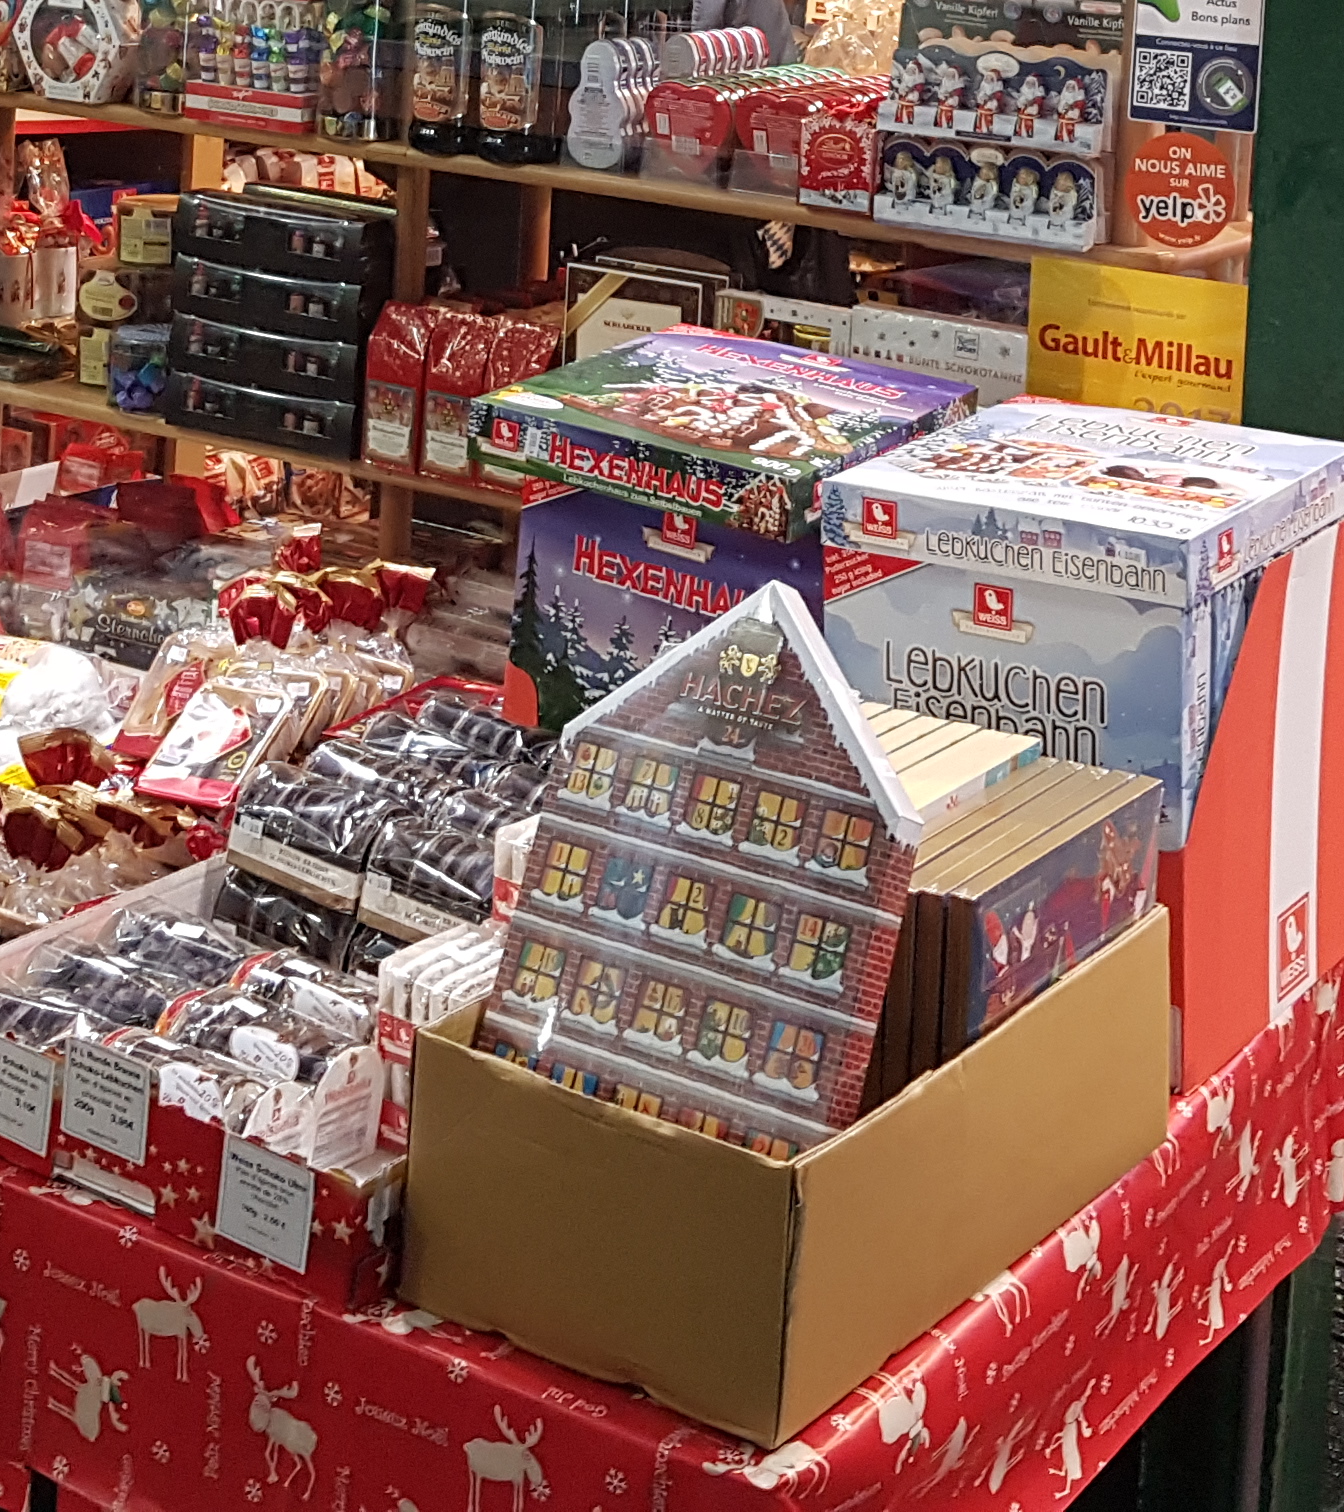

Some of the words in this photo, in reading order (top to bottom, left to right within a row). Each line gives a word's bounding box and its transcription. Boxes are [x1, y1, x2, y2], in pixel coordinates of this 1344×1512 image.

[934, 0, 965, 15] Vanille
[967, 4, 999, 19] Kipferl
[1067, 14, 1101, 29] Vanille
[1102, 17, 1124, 32] Kipf
[1191, 11, 1218, 24] Bons
[1220, 13, 1251, 27] plans
[1168, 145, 1193, 160] ON
[1134, 156, 1182, 175] NOUS
[1184, 161, 1227, 179] AIME
[1169, 177, 1190, 188] SUR
[1138, 194, 1195, 228] yelp
[1039, 322, 1233, 380] Gault&Millau
[693, 343, 907, 401] HEXENHAUS
[908, 354, 940, 371] BUNTE
[944, 359, 1024, 385] SCHOKOTANNE
[1177, 379, 1232, 393] gourmand
[548, 432, 727, 511] HEXENHAUS
[751, 456, 787, 472] 900
[563, 473, 630, 499] Lebkuchenhaus
[631, 491, 648, 502] zum
[924, 530, 1044, 572] Lebkuchen
[1051, 551, 1168, 595] Eisenbahn
[884, 639, 1109, 726] Lebkuchen
[679, 671, 809, 726] HACHEZ
